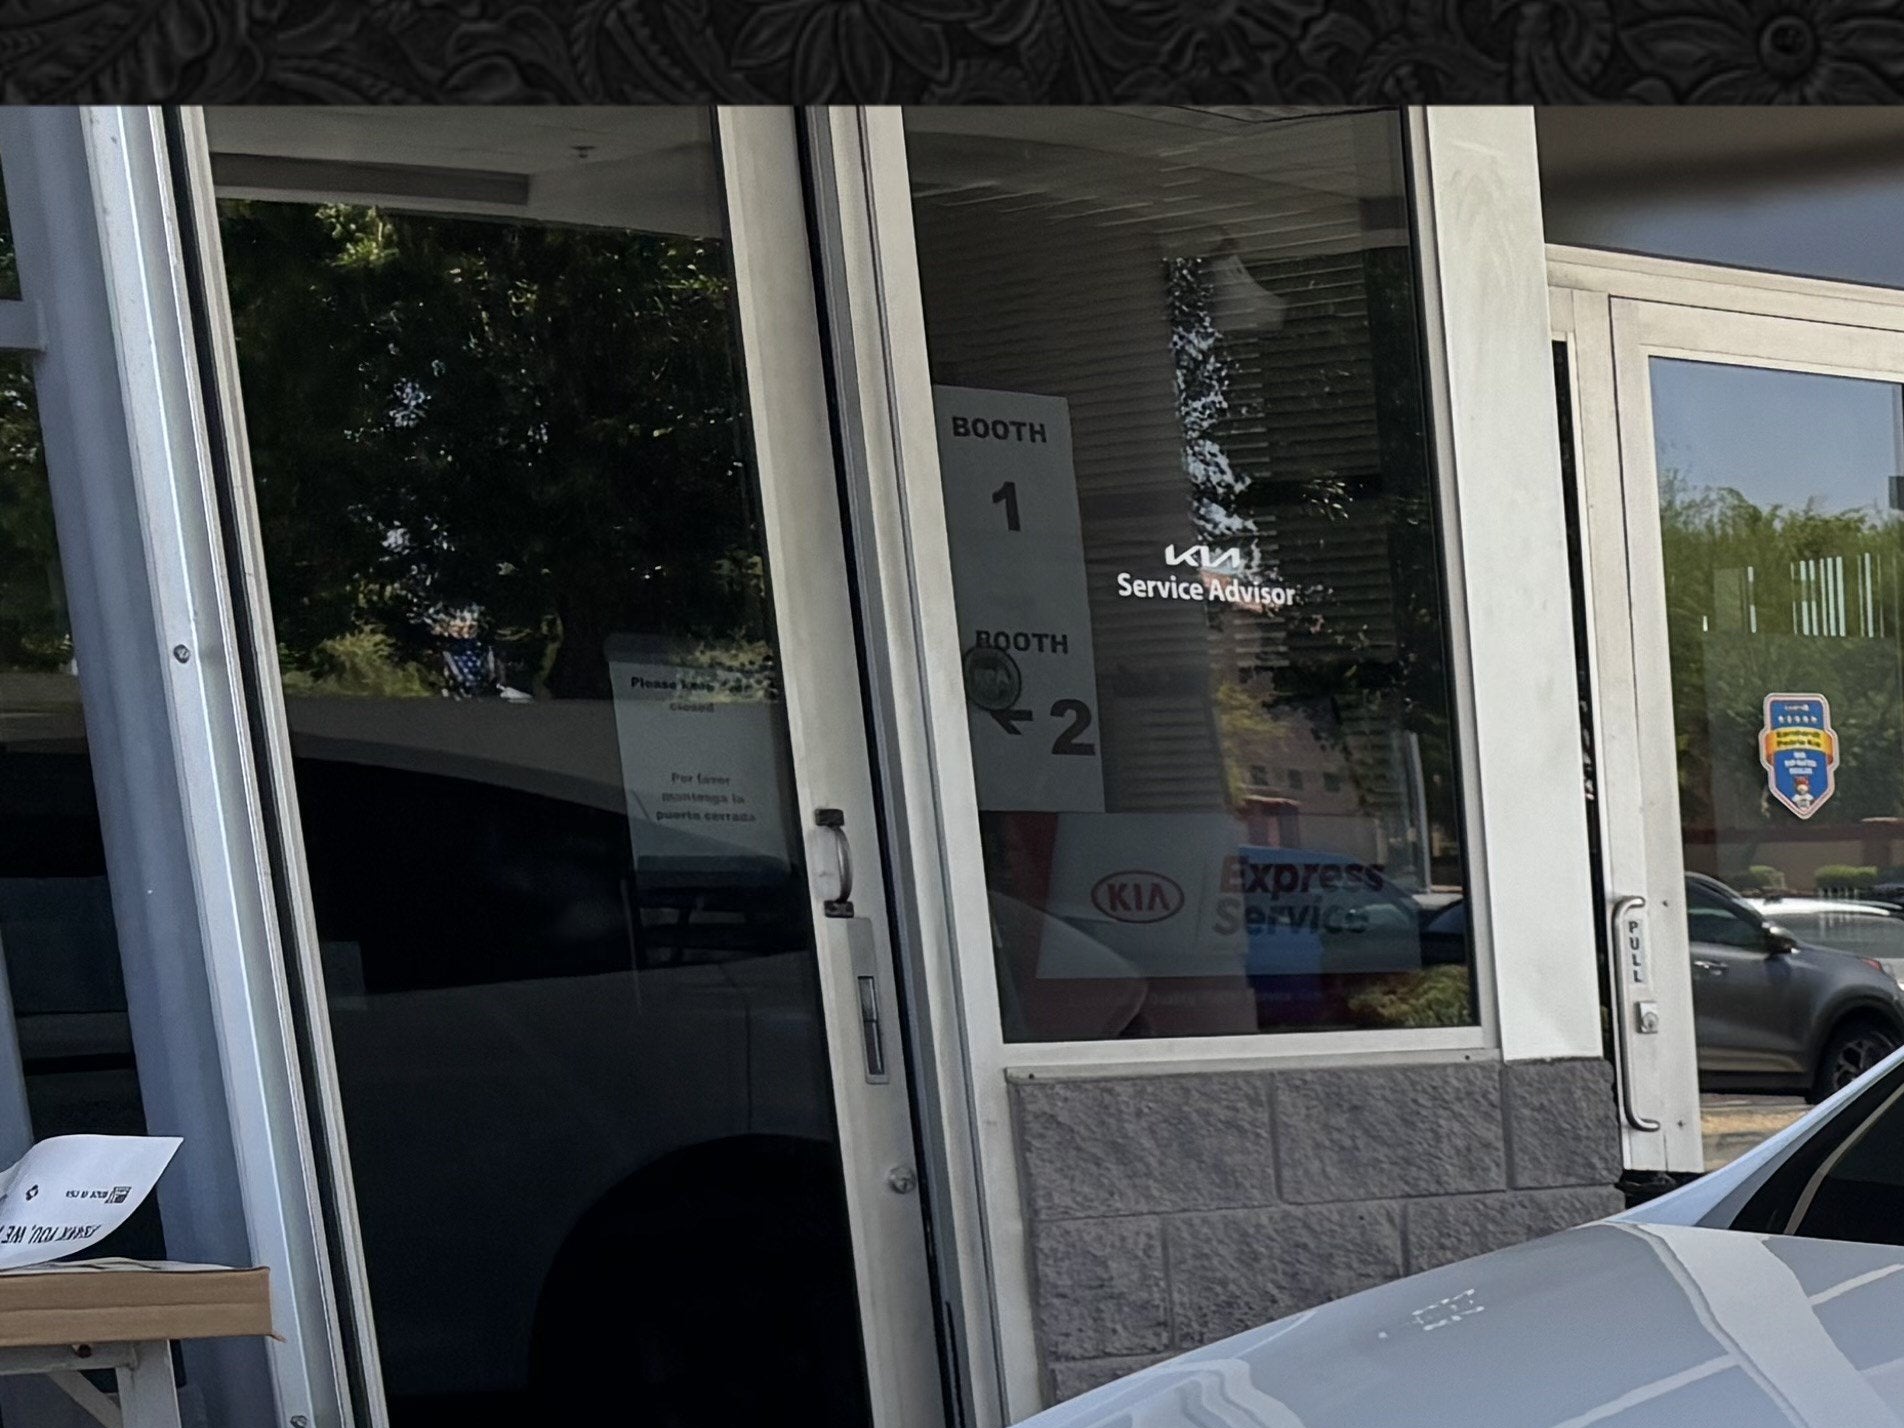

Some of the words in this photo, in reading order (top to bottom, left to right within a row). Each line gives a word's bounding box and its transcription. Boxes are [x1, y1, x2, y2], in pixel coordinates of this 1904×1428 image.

[952, 416, 1047, 443] BOOTH
[992, 481, 1021, 531] 1
[1165, 544, 1240, 568] KIA
[1117, 572, 1203, 601] Service
[1209, 580, 1296, 605] Advisor
[976, 630, 1069, 655] BOOTH
[631, 676, 677, 690] Please
[1050, 699, 1097, 756] 2
[1106, 882, 1172, 912] KIA
[1219, 855, 1385, 902] Express
[1213, 902, 1371, 936] Service
[1628, 920, 1643, 984] PULL
